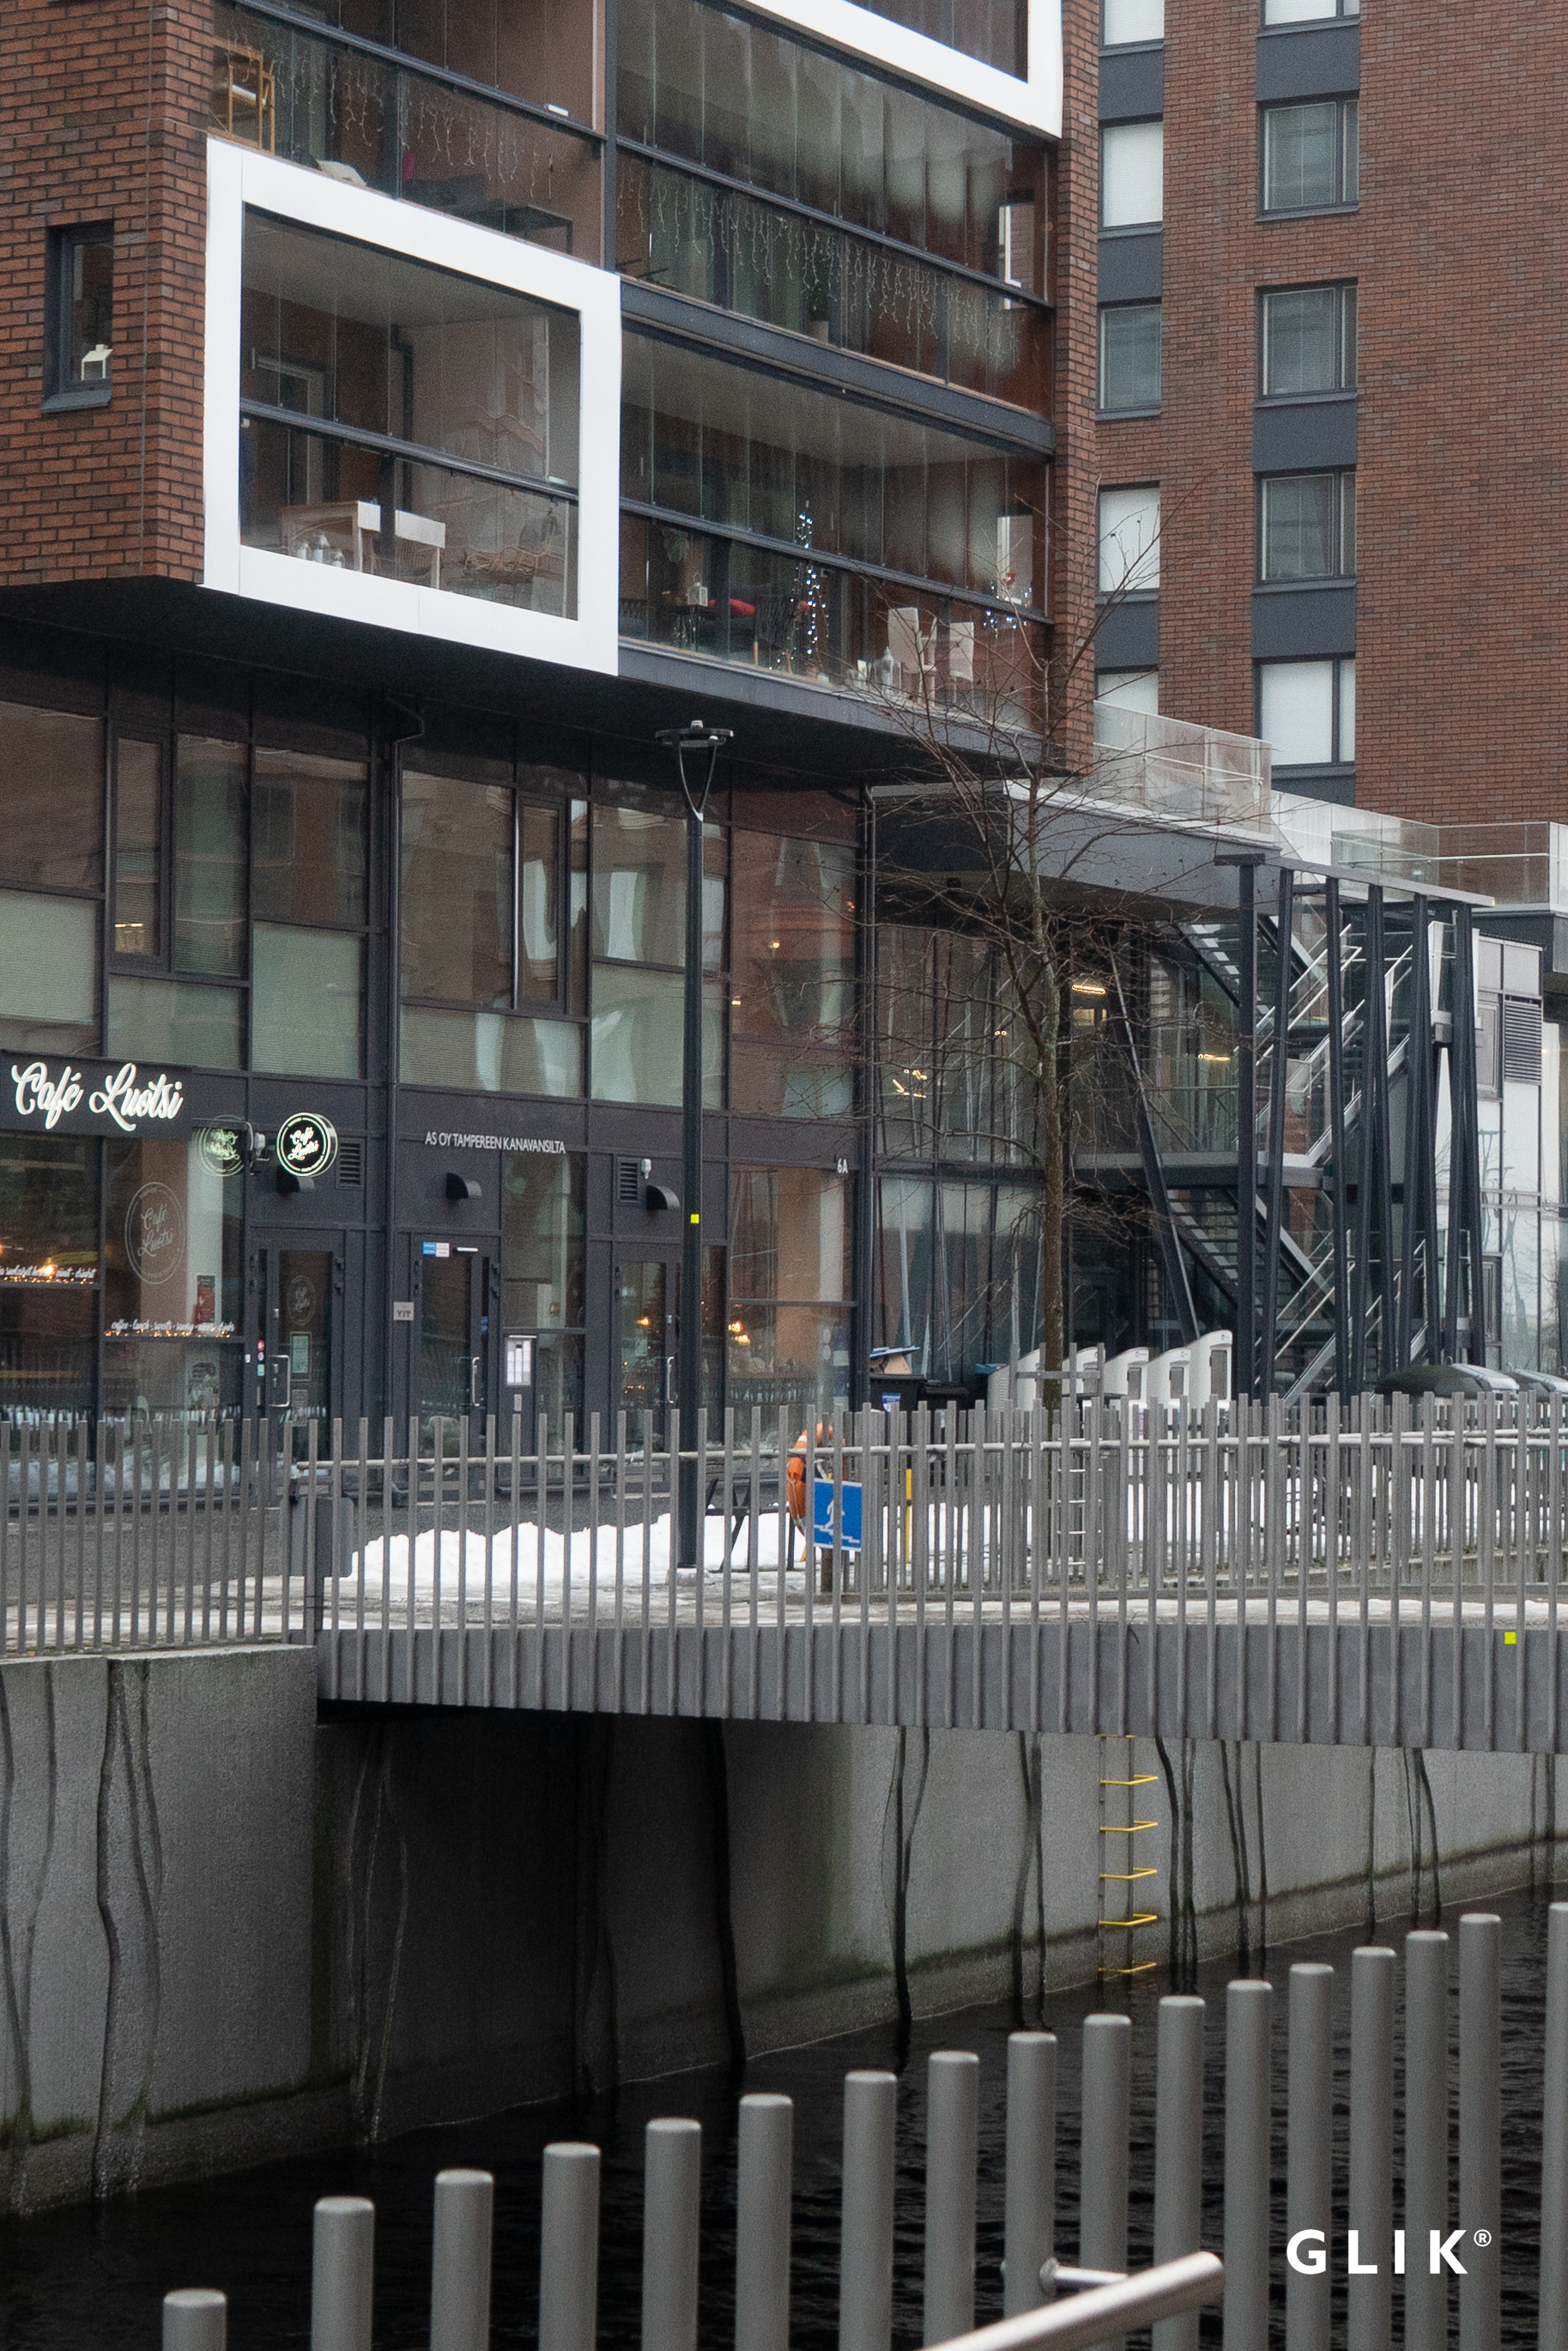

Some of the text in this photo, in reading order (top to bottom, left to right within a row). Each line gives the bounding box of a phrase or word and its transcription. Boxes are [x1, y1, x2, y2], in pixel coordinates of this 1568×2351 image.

[11, 1062, 184, 1132] Café Luotsi
[425, 1130, 566, 1154] AS OY TAMPEREEN KANAVANSILTA
[837, 1157, 849, 1174] 6A
